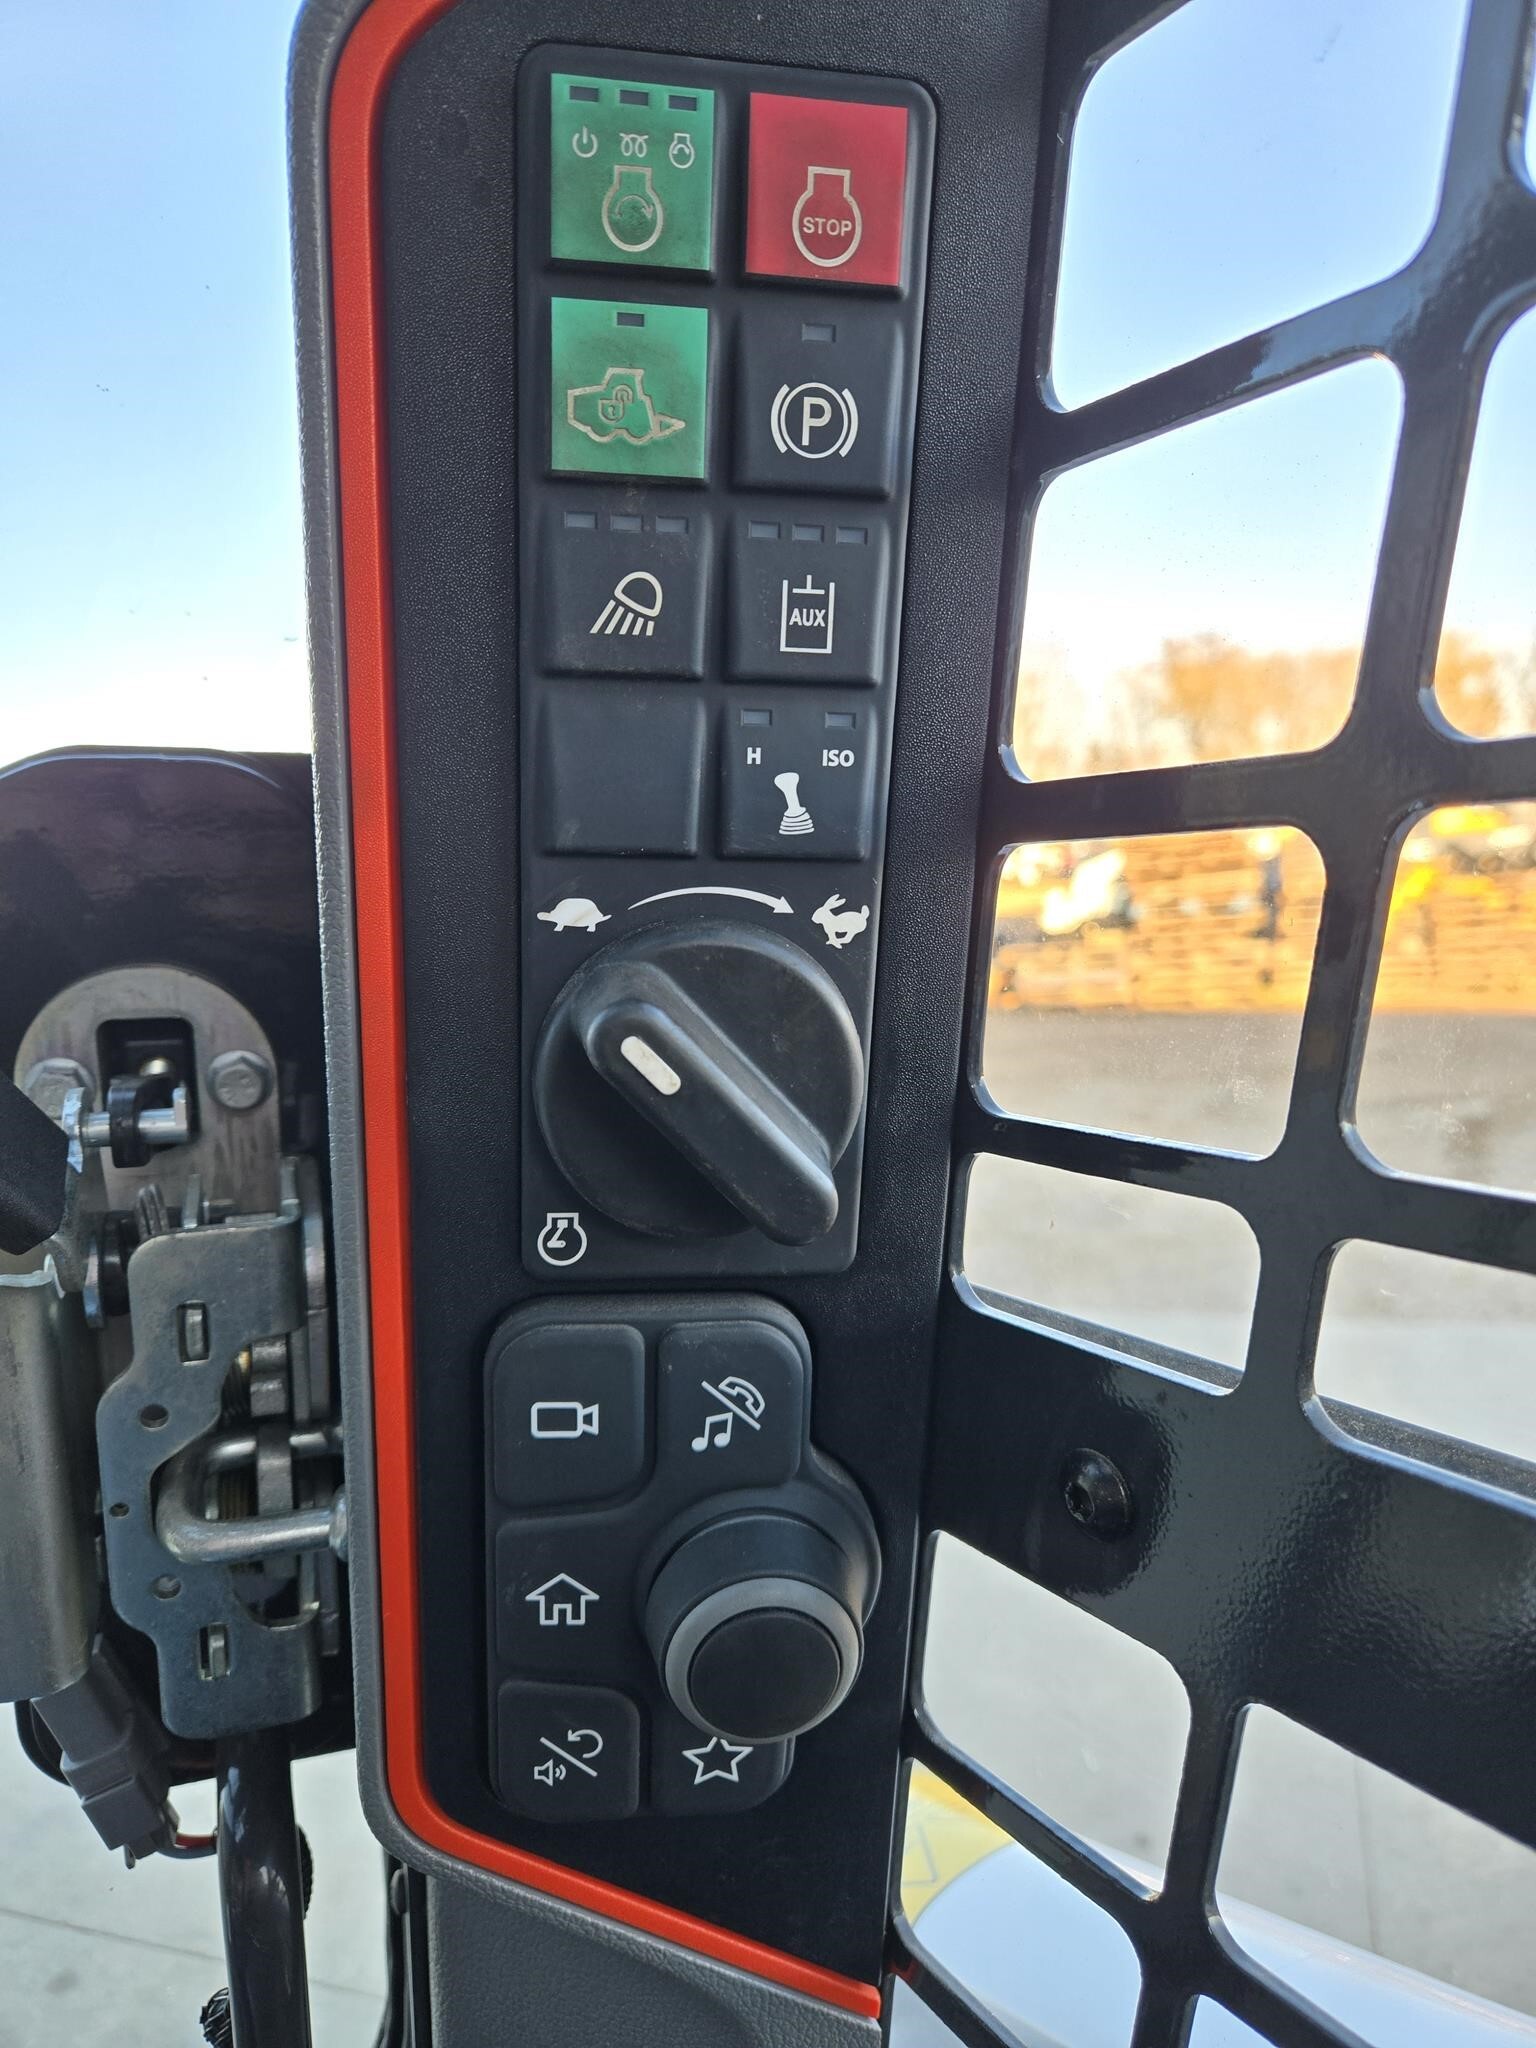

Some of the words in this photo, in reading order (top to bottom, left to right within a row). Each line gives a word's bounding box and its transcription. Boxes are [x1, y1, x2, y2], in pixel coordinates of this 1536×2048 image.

[803, 216, 852, 237] STOP
[801, 396, 832, 446] P
[788, 607, 826, 627] AUX
[746, 746, 762, 765] H
[822, 749, 855, 767] ISO
